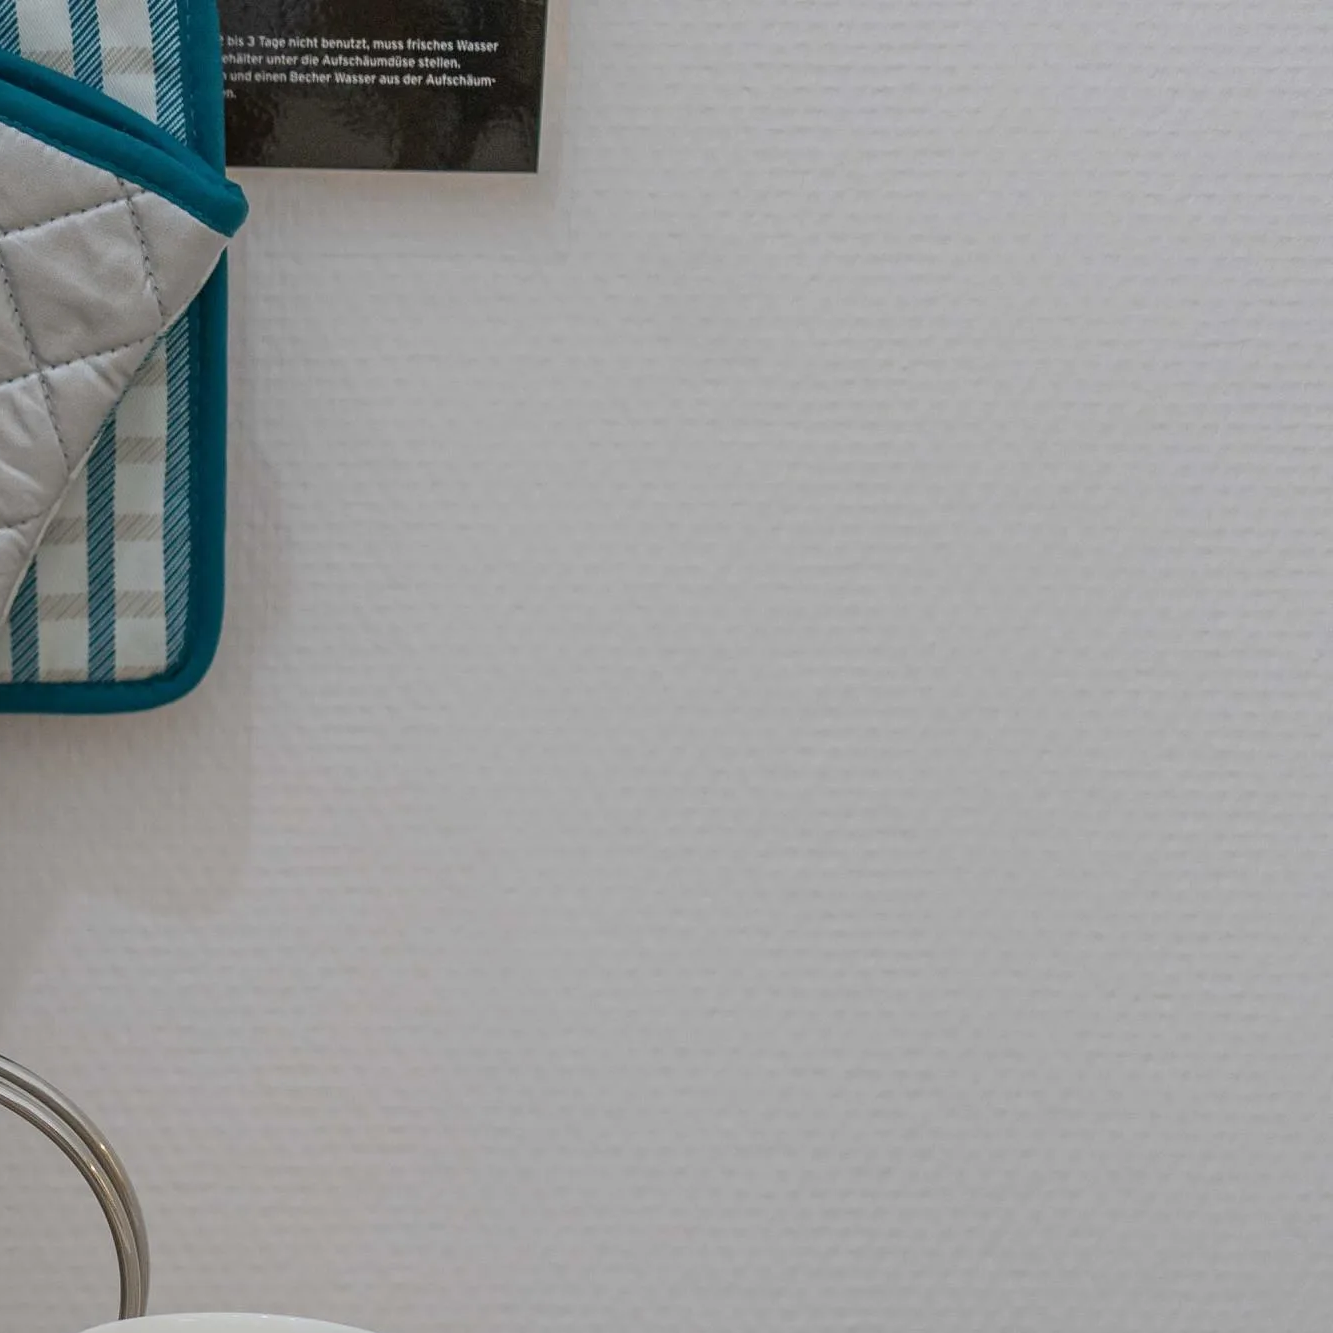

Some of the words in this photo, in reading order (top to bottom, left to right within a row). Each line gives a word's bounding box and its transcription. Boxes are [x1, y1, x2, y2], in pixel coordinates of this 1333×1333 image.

[227, 35, 244, 47] bis
[246, 36, 255, 47] 3
[259, 35, 286, 49] Tage
[288, 36, 318, 49] nicht
[321, 38, 369, 51] benutzt,
[372, 40, 404, 50] muss
[406, 38, 454, 51] frisches
[456, 39, 499, 52] Wasser
[266, 54, 299, 66] unter
[301, 54, 319, 66] die
[322, 55, 416, 68] Aufschäumdüse
[230, 71, 252, 82] und
[254, 71, 287, 83] einen
[289, 71, 332, 83] Becher
[334, 72, 376, 85] Wasser
[378, 76, 400, 85] aus
[403, 73, 423, 85] der
